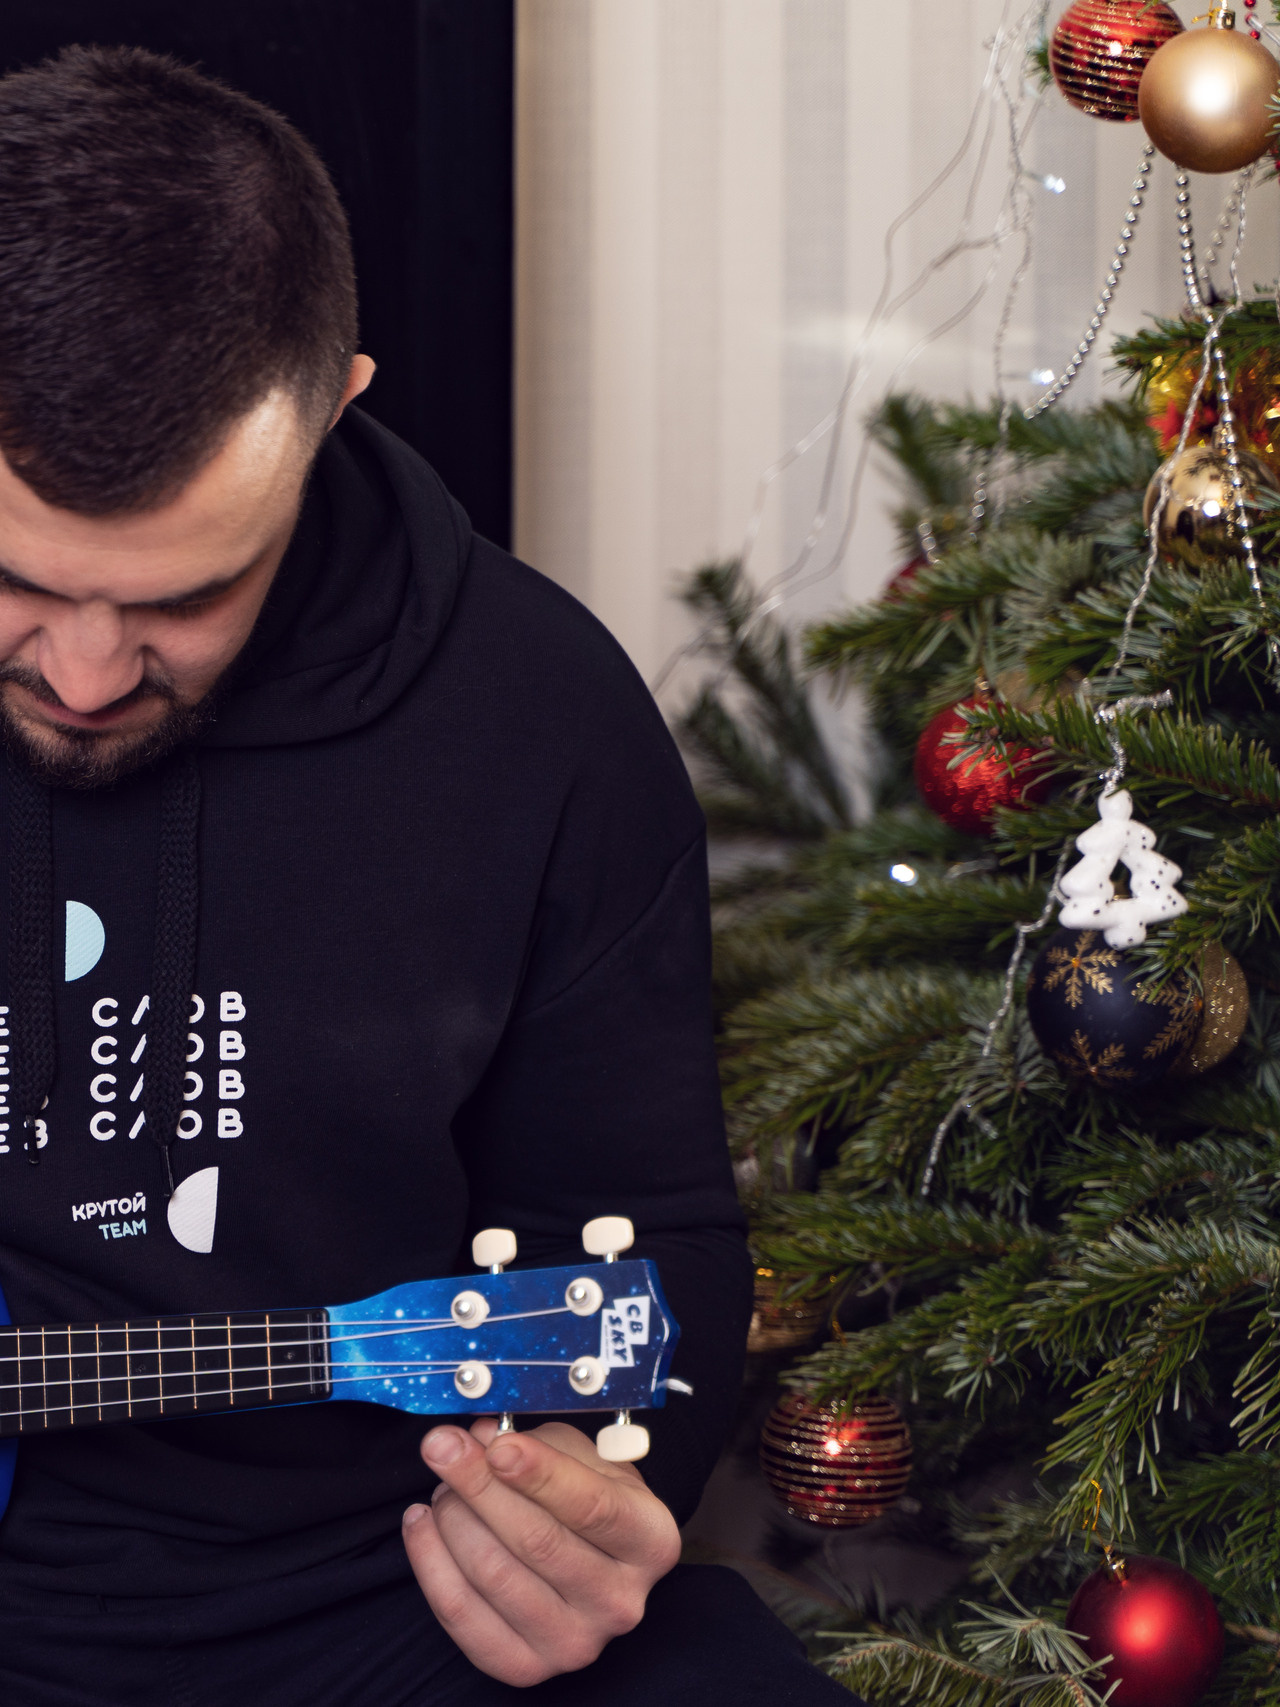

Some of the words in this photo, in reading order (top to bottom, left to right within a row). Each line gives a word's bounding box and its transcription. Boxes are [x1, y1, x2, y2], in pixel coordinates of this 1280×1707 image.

[71, 1191, 147, 1222] КРУТОЙ
[98, 1218, 148, 1240] TEAM
[626, 1303, 643, 1334] CB
[608, 1314, 628, 1363] SKY
